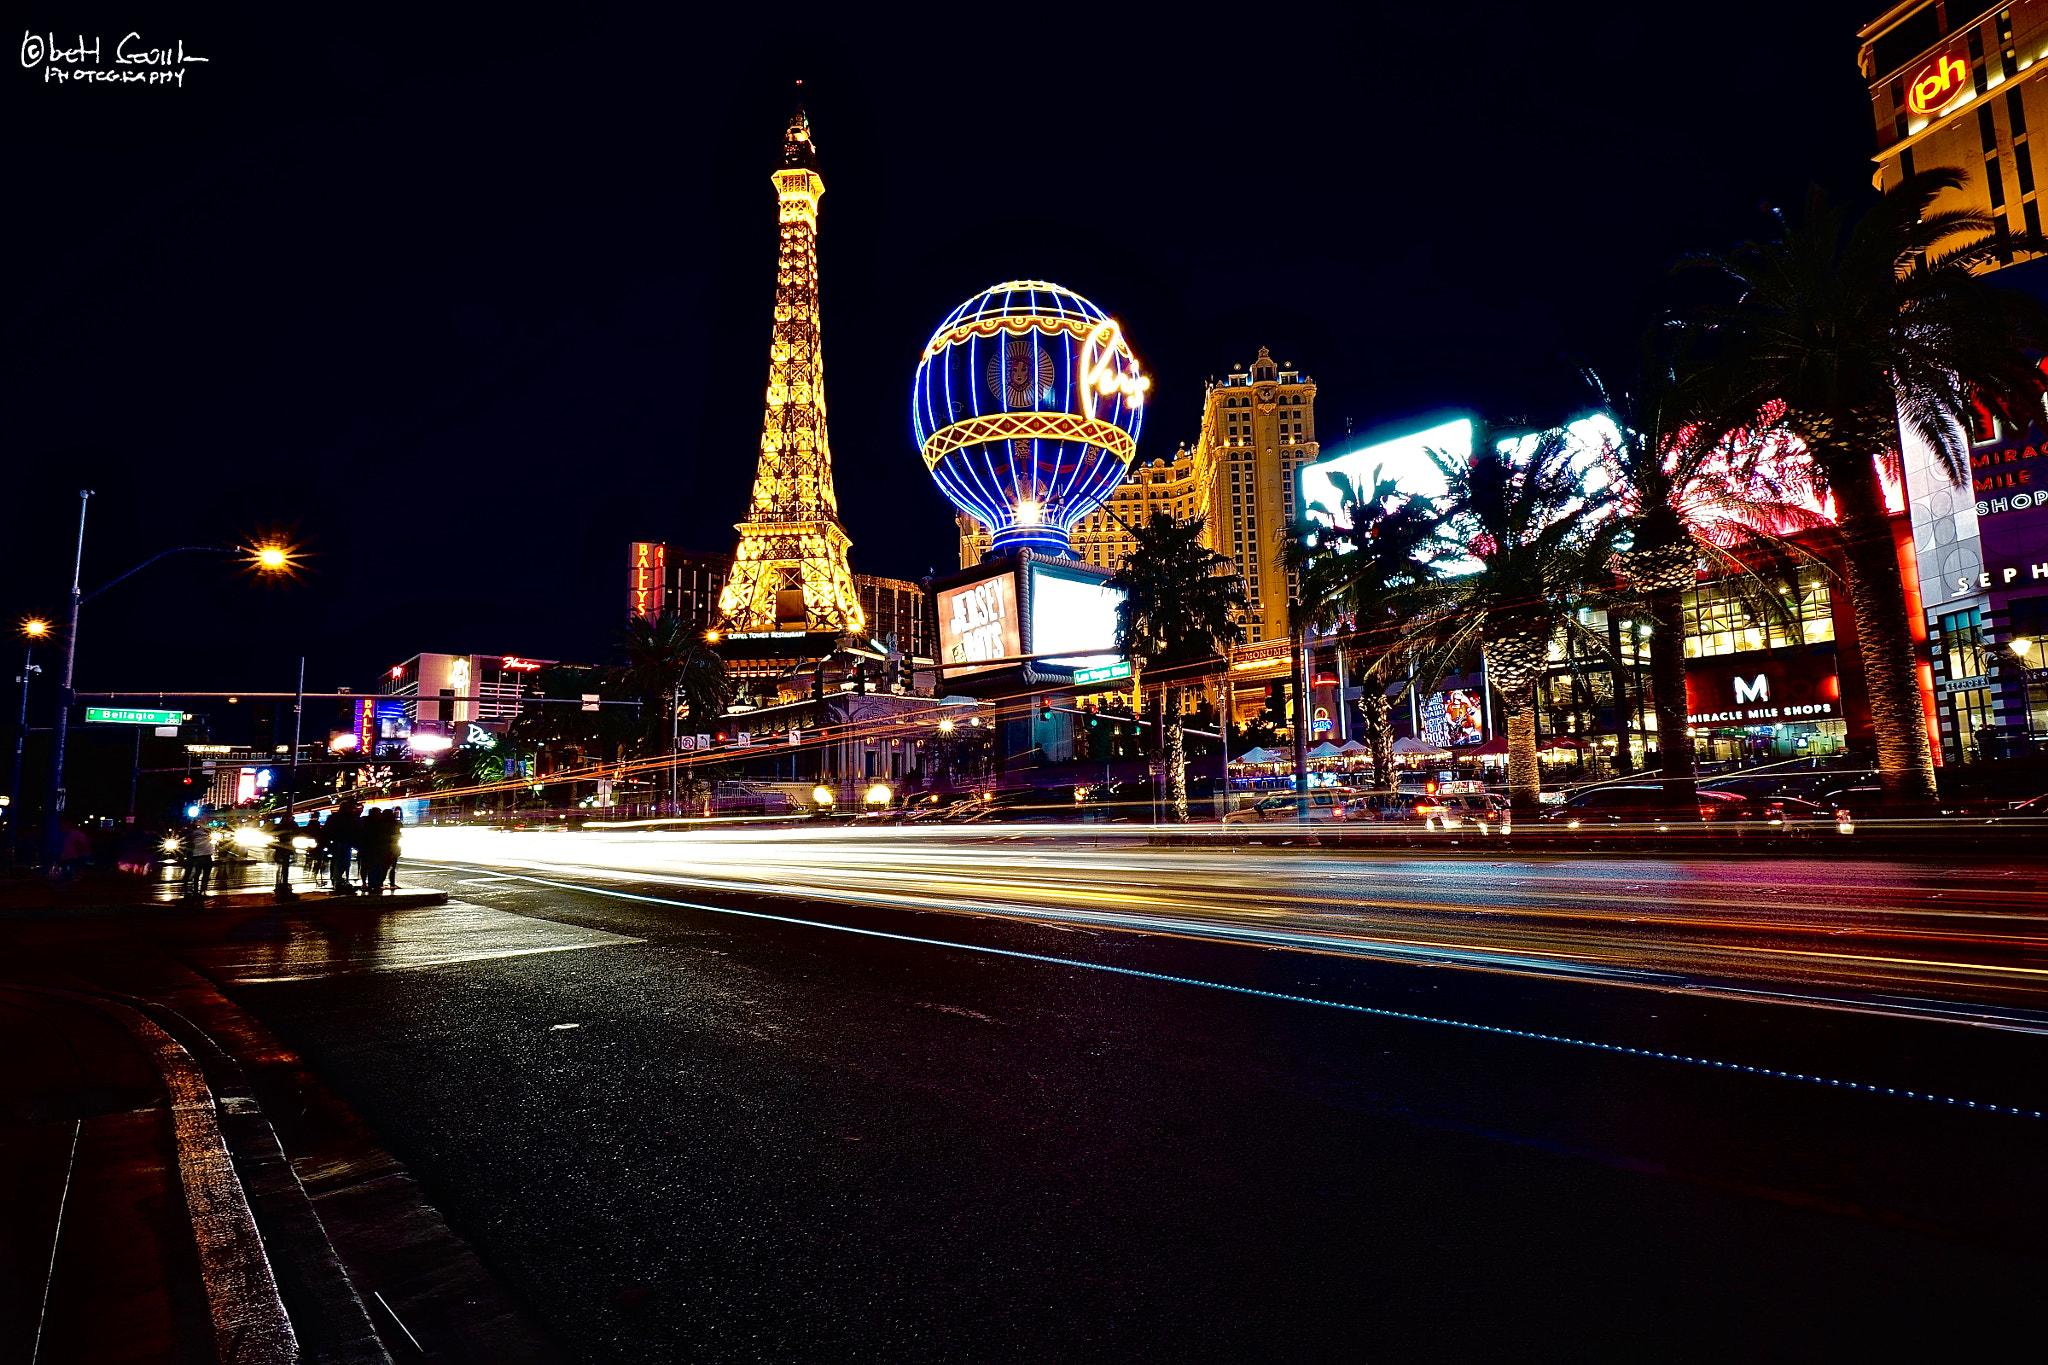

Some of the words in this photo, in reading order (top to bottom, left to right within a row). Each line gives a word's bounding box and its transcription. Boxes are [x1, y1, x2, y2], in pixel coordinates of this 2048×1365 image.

[1914, 55, 1967, 109] ph
[1973, 469, 2031, 492] MILE
[1957, 562, 2048, 593] SEPH
[950, 576, 1006, 635] JERSEY
[102, 710, 154, 721] Bellagio
[1687, 711, 1743, 724] MIRACLE
[1748, 708, 1778, 719] MILE
[1783, 703, 1832, 716] SHOPS
[1425, 729, 1451, 743] ROCK
